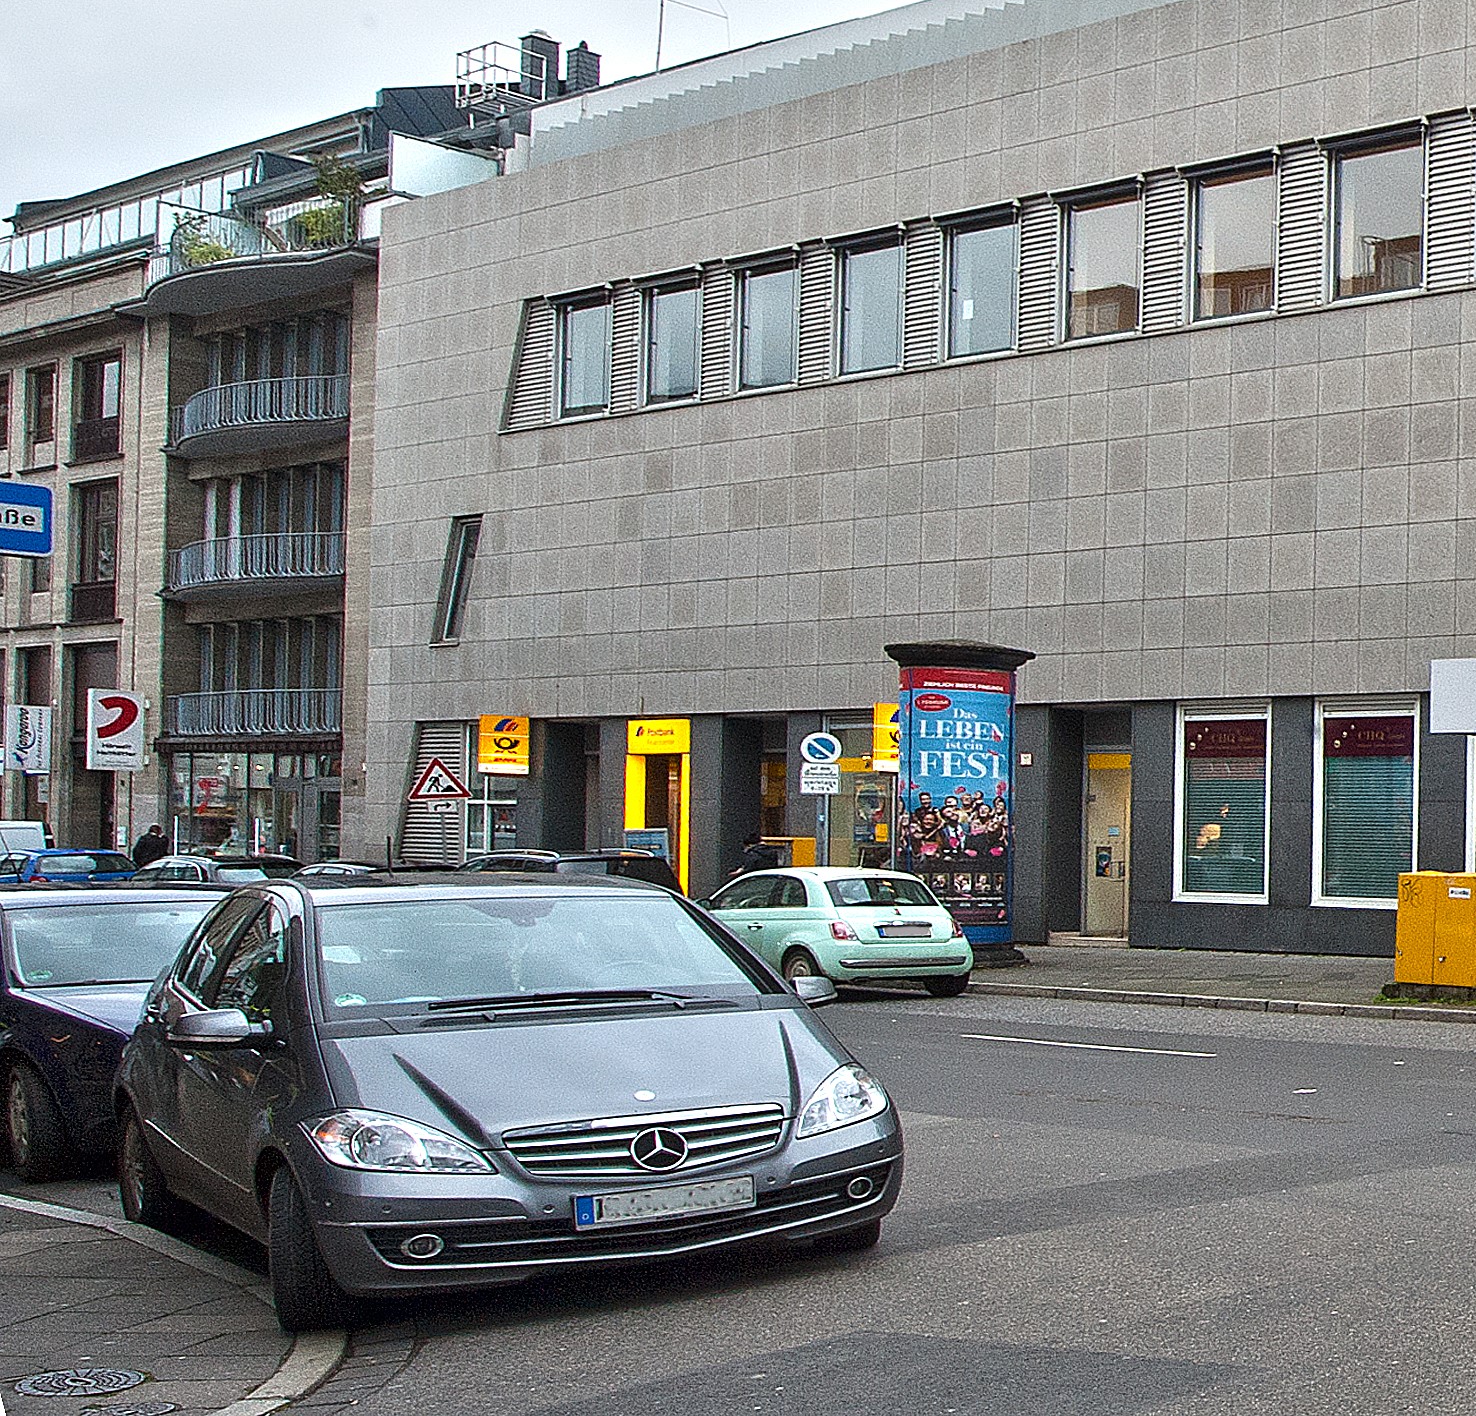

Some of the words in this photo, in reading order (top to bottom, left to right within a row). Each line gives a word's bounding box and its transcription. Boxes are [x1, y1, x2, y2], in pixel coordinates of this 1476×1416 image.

[0, 509, 36, 526] ße
[953, 708, 978, 719] Das
[919, 719, 1005, 742] LEBEN
[945, 740, 961, 750] ist
[963, 740, 983, 751] ein
[919, 750, 1006, 779] FEST
